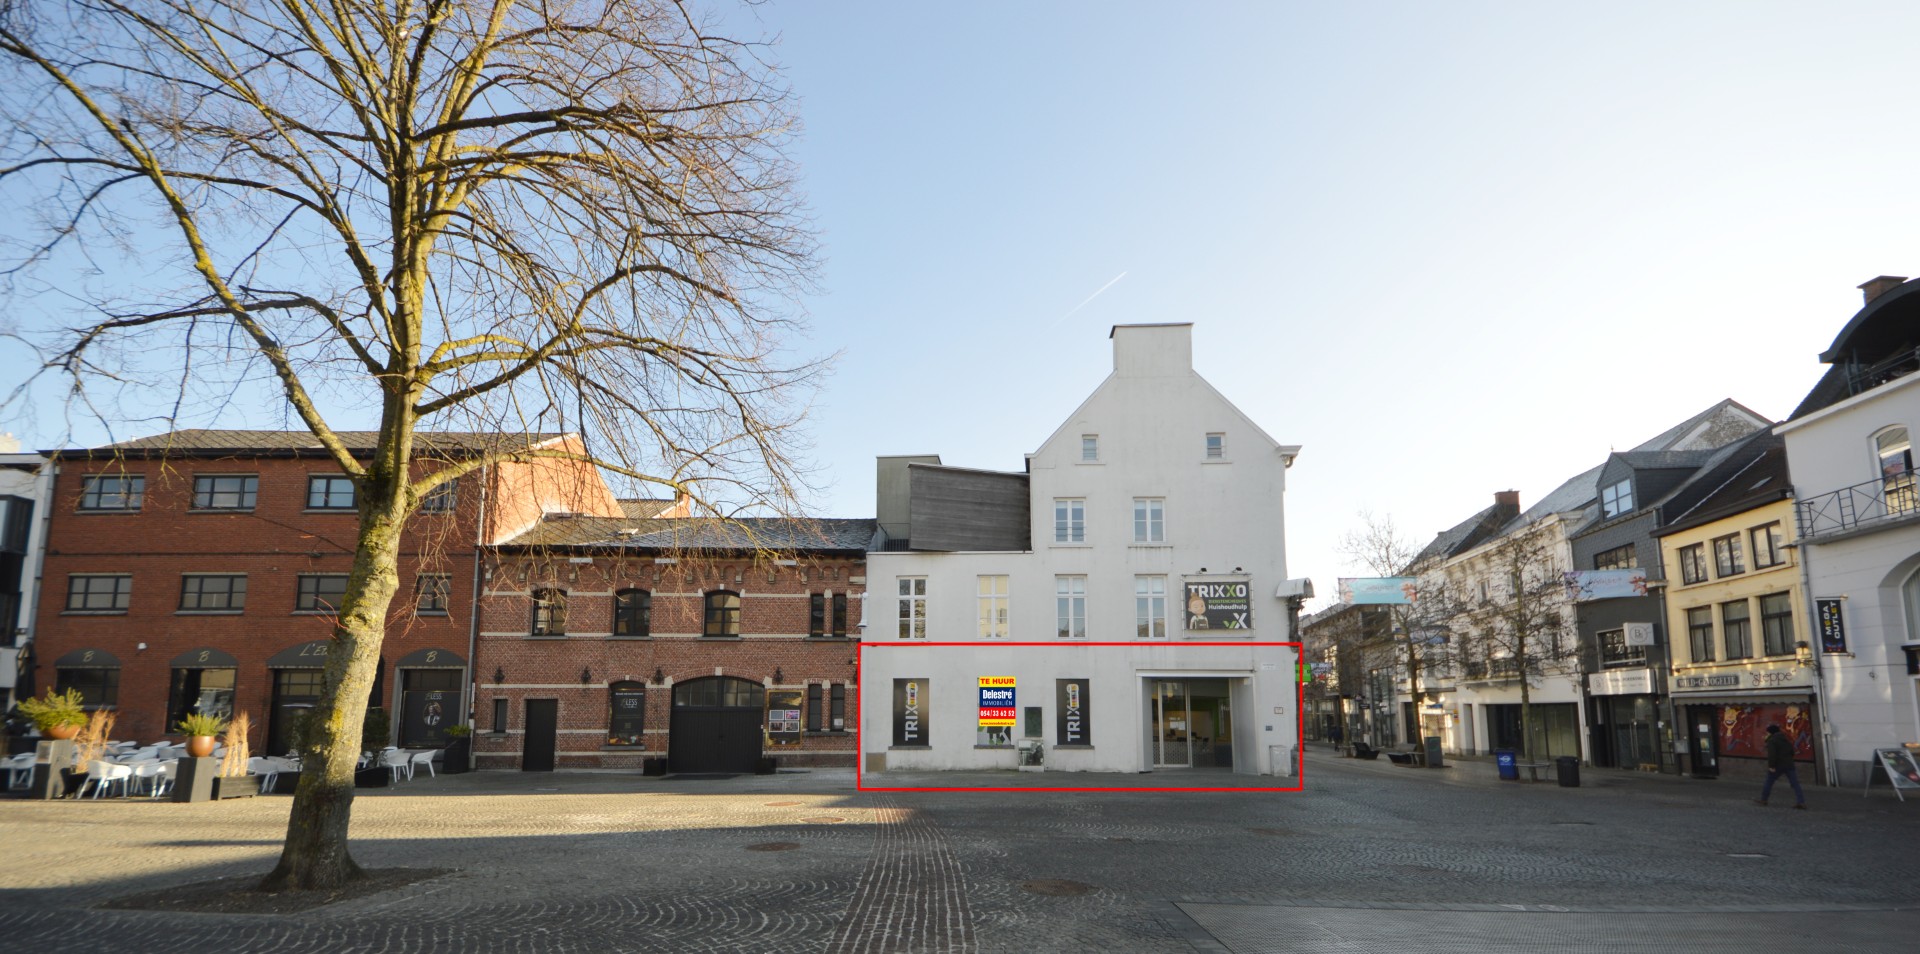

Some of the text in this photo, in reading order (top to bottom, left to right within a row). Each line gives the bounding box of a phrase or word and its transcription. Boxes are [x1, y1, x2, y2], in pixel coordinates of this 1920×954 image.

[1188, 584, 1247, 598] TRIXXO
[1823, 605, 1832, 635] MEGA
[1830, 601, 1841, 639] OUTLET
